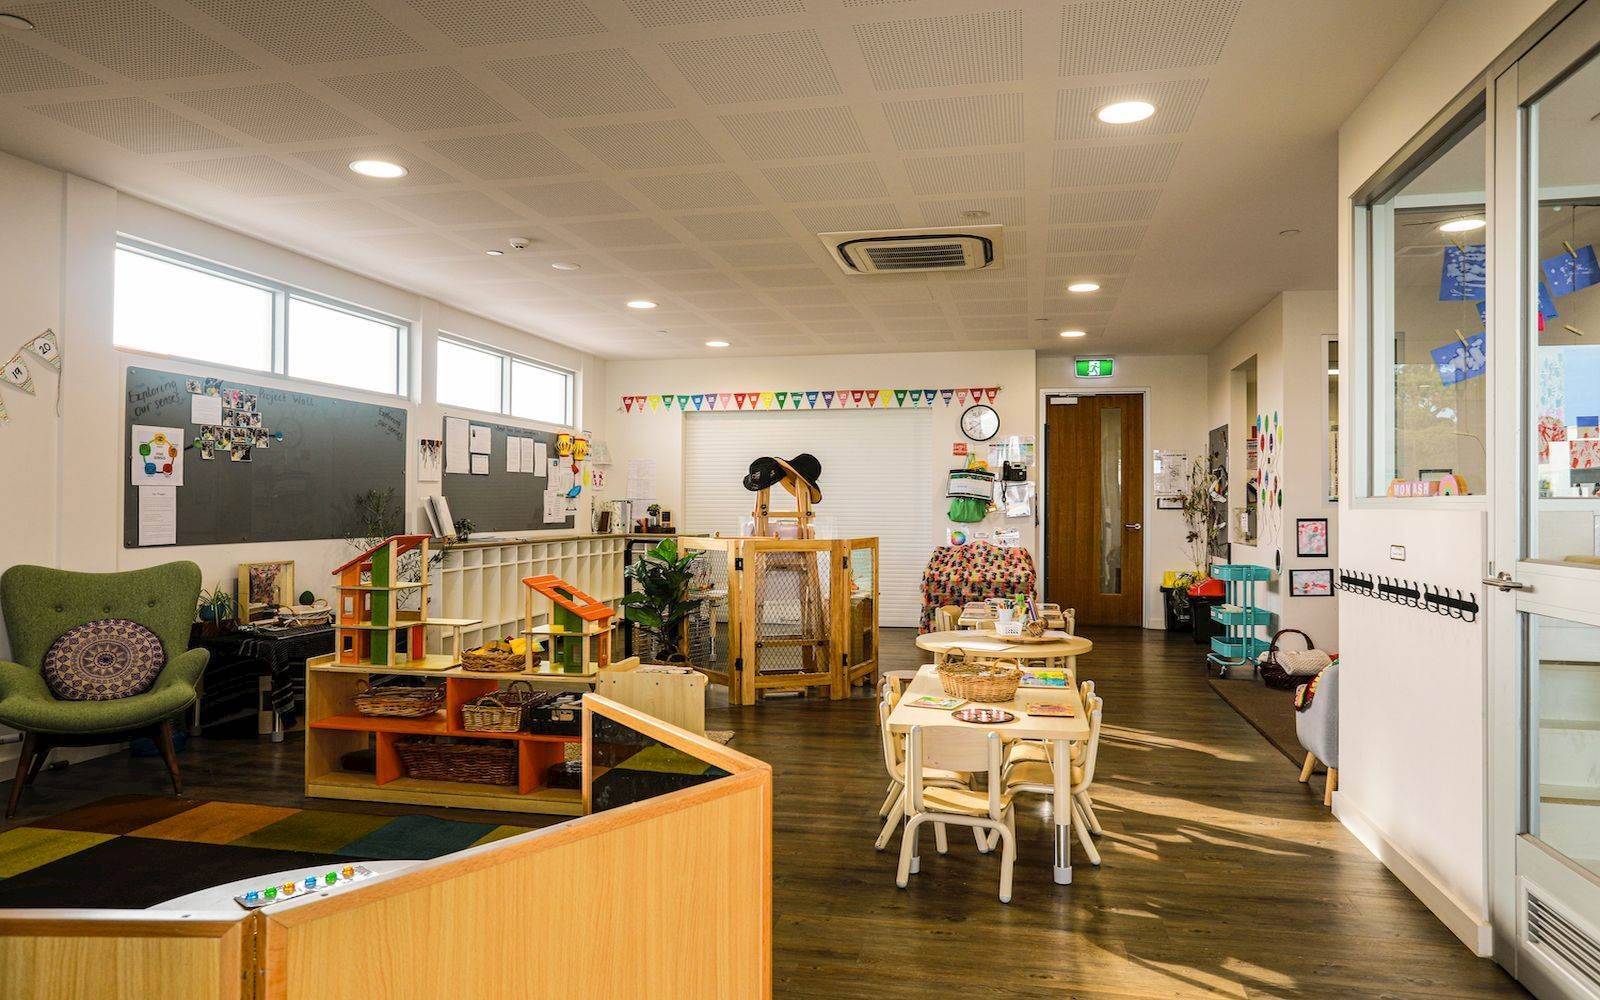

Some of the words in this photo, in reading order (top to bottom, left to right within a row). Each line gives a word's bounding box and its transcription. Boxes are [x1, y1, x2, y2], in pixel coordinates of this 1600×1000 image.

[39, 343, 51, 354] 20
[12, 367, 22, 379] 19
[128, 381, 178, 403] Exploring
[1393, 481, 1430, 496] MONASH
